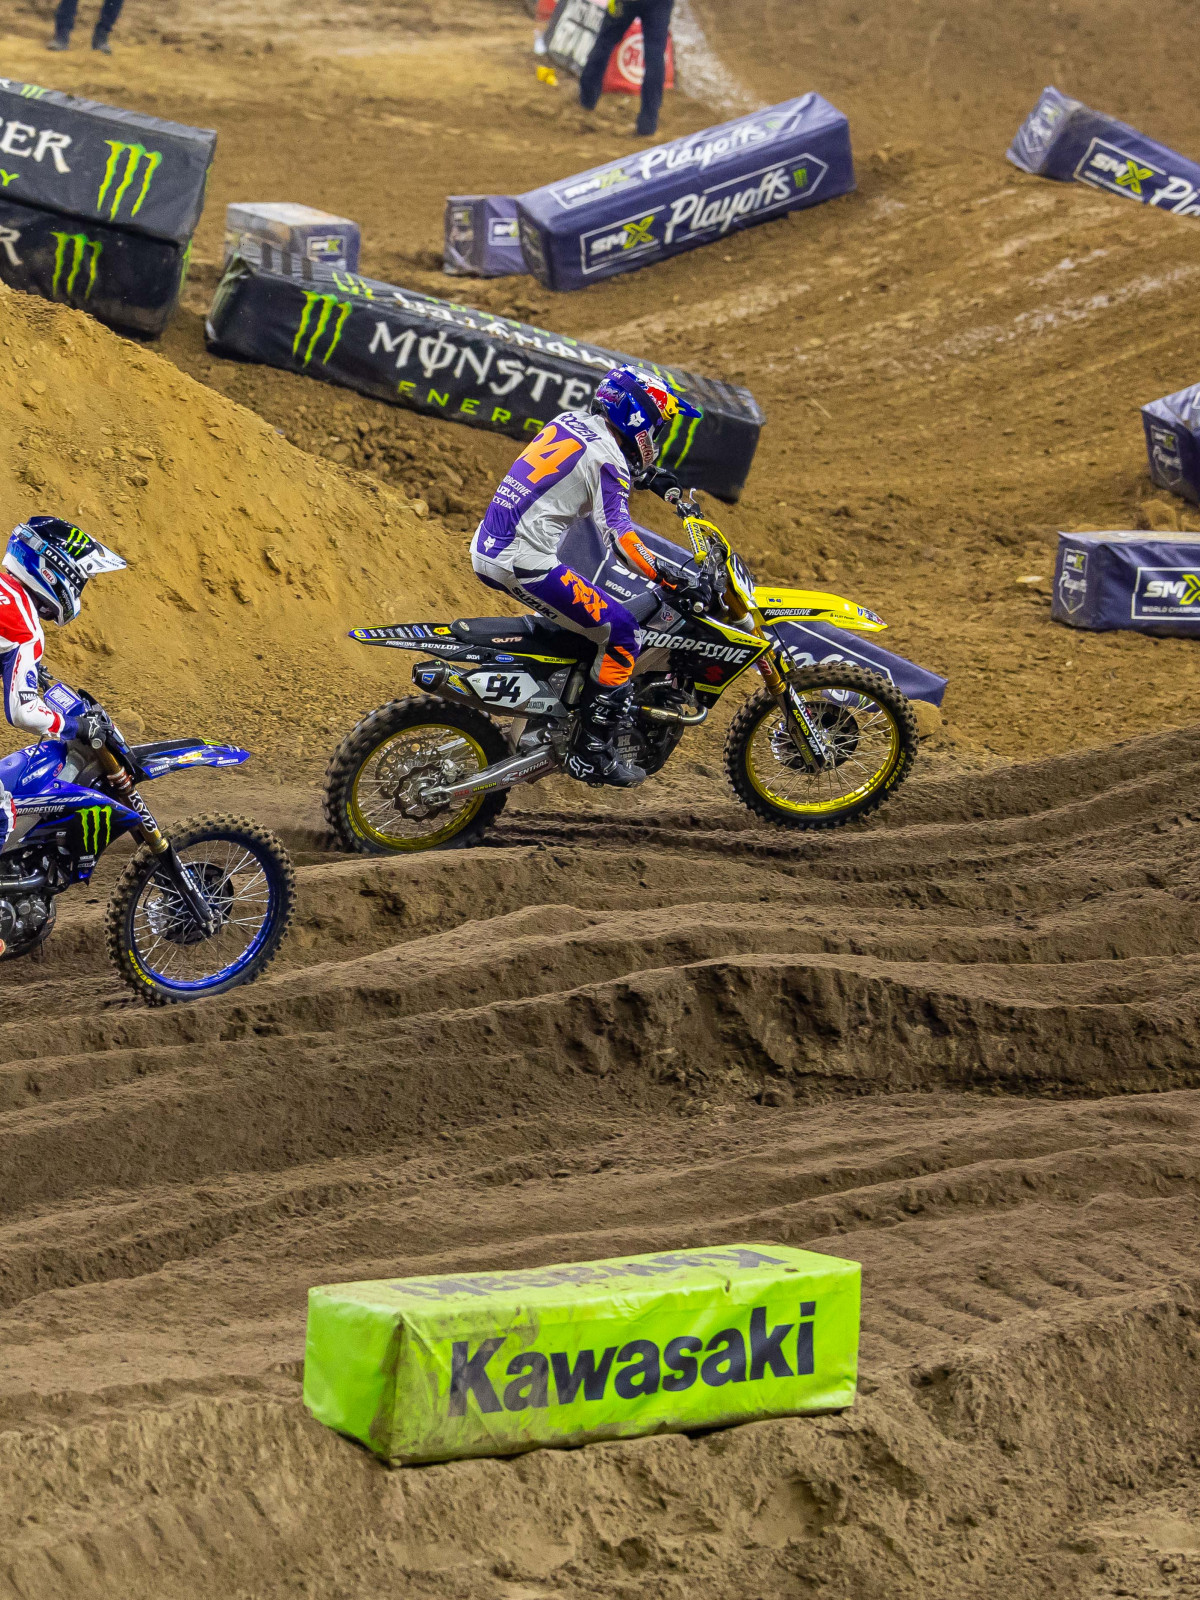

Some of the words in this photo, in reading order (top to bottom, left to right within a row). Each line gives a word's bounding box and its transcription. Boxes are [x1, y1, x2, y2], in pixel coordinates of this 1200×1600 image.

[638, 122, 768, 181] Playoffs
[1090, 153, 1155, 195] SMX
[590, 214, 656, 254] SMX
[664, 166, 792, 244] Playoffs
[368, 320, 595, 413] MONSTE
[399, 379, 545, 434] ENERG
[515, 424, 583, 485] 94
[497, 485, 521, 505] UZUKI
[41, 568, 54, 583] BELL
[45, 548, 82, 585] OAKLEY
[511, 585, 559, 620] SUZUKI
[604, 579, 632, 599] WORLD
[765, 608, 812, 616] PROGRESSIVE
[420, 642, 460, 651] DUNLOP
[491, 635, 523, 644] GUTS
[482, 674, 522, 703] 94
[589, 701, 611, 716] FOX
[884, 750, 906, 790] DUNLOP
[127, 790, 159, 833] KYB
[128, 949, 155, 986] DUNLOP
[447, 1301, 817, 1418] Kawasaki
